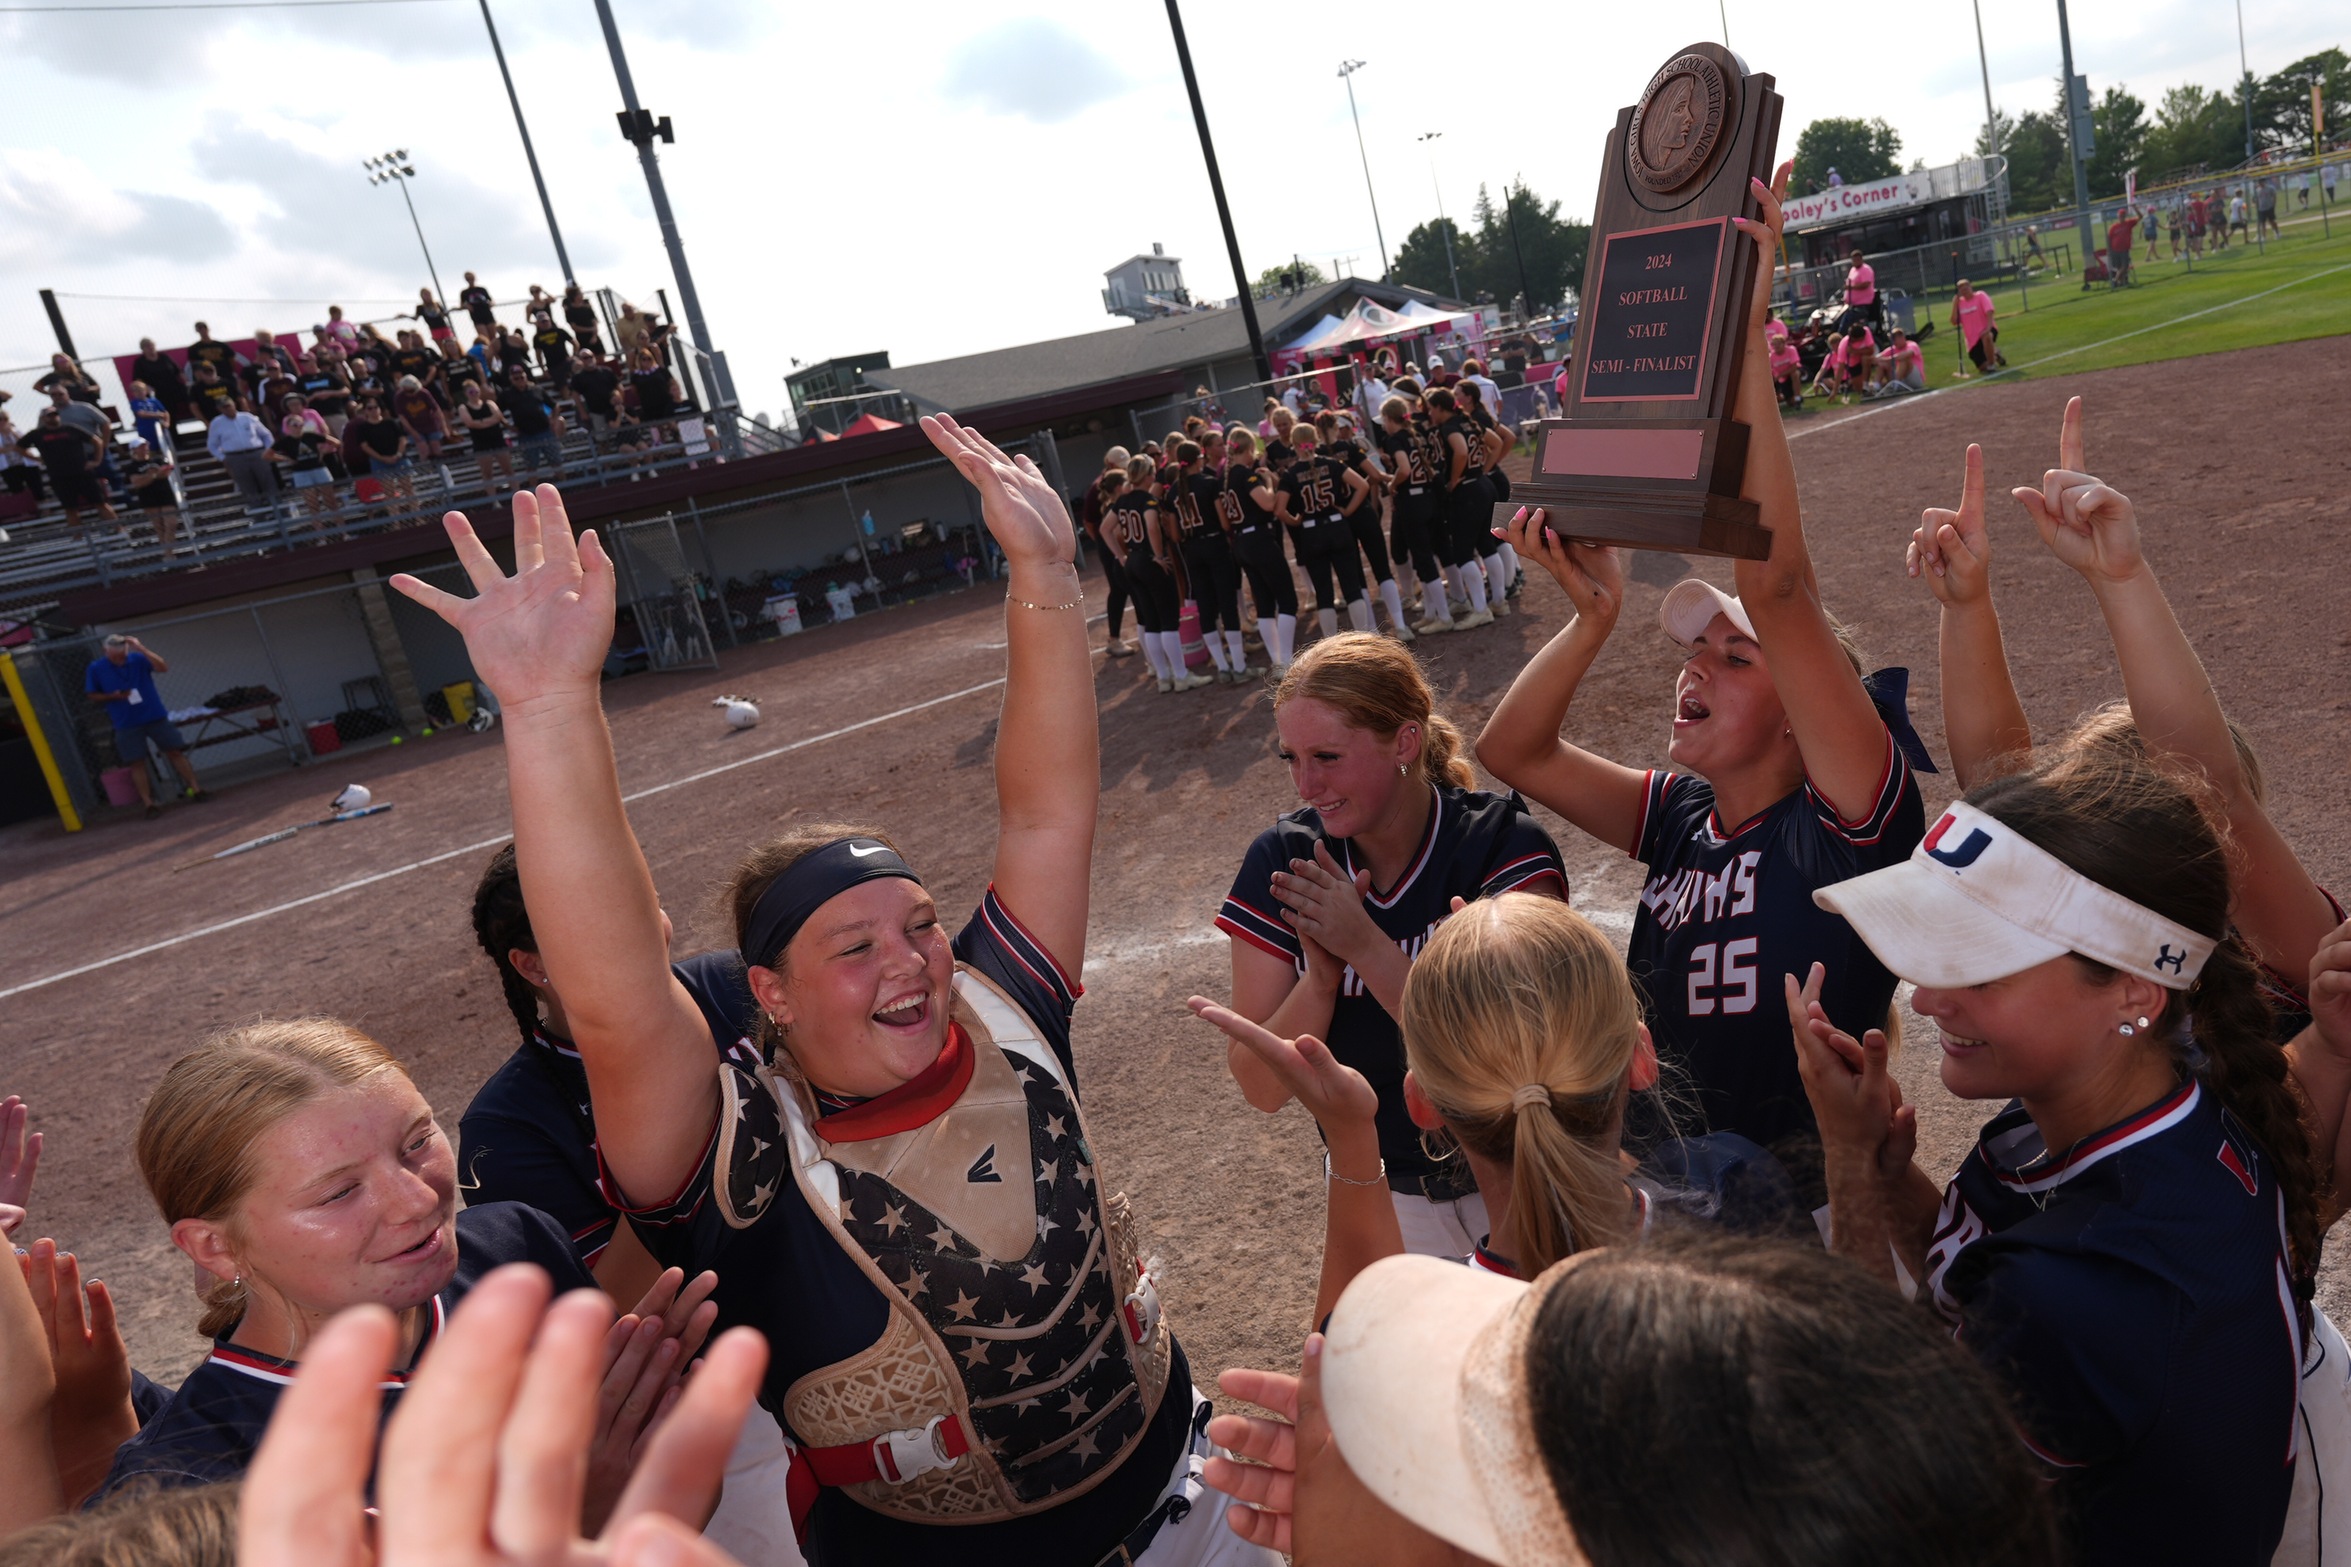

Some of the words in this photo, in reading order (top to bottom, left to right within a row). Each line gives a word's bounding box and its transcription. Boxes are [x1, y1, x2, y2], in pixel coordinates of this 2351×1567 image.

[1666, 57, 1702, 75] SCHOOL
[1642, 72, 1665, 105] HIGH
[1700, 65, 1720, 121] ATHLETIC
[1630, 106, 1643, 146] GIRLS
[1630, 147, 1643, 178] IOWA
[1688, 122, 1718, 168] UNION
[1782, 197, 1837, 222] ooley's
[1842, 184, 1898, 208] Corner
[1645, 253, 1672, 270] 2024
[1618, 286, 1688, 306] SOFTBALL
[1626, 322, 1668, 339] STATE
[1591, 359, 1624, 374] SEMI
[1633, 355, 1696, 373] FINALIST
[1173, 491, 1205, 531] 11
[1300, 478, 1336, 514] 15
[1923, 812, 1993, 868] U
[1688, 936, 1758, 1017] 25
